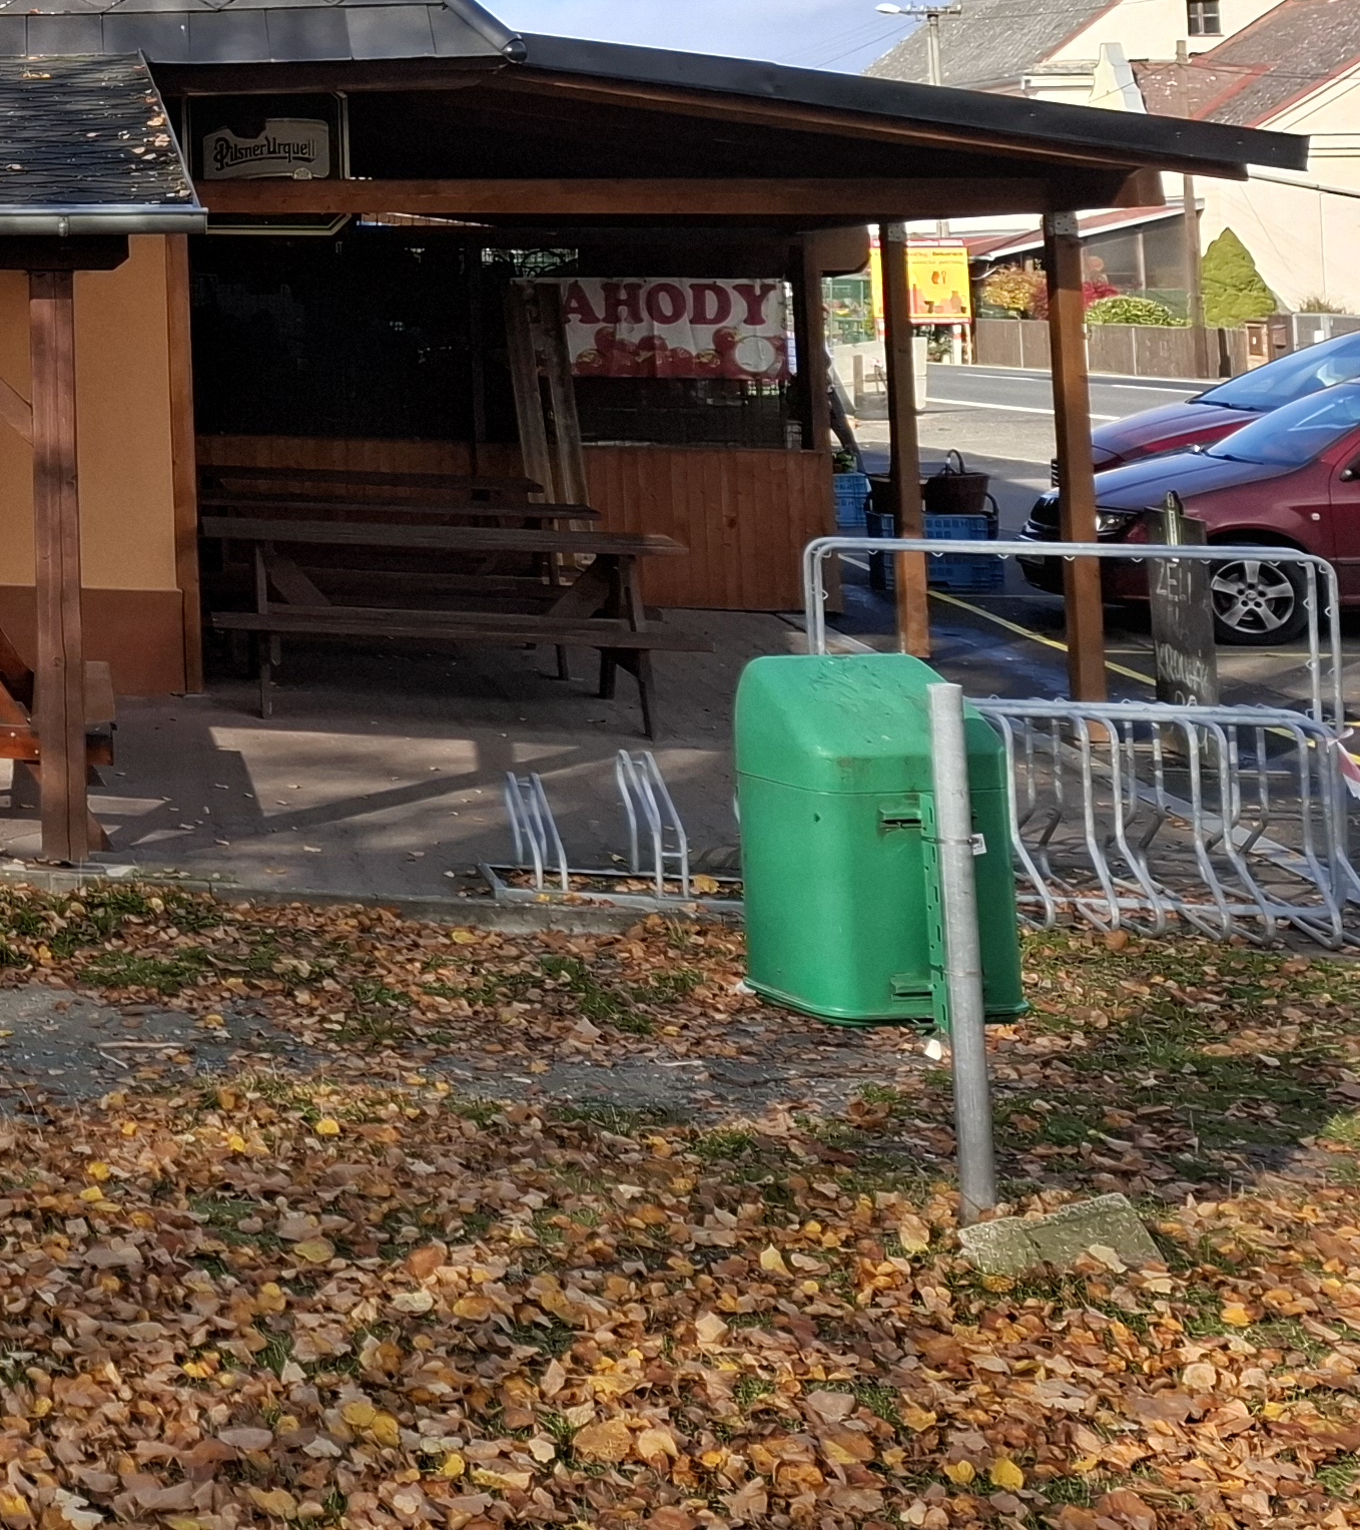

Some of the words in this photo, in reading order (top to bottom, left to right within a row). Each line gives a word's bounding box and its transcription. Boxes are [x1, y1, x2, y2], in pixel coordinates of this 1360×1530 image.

[212, 136, 266, 171] Pilsner
[265, 135, 316, 163] Urquell
[562, 282, 775, 326] AHODY
